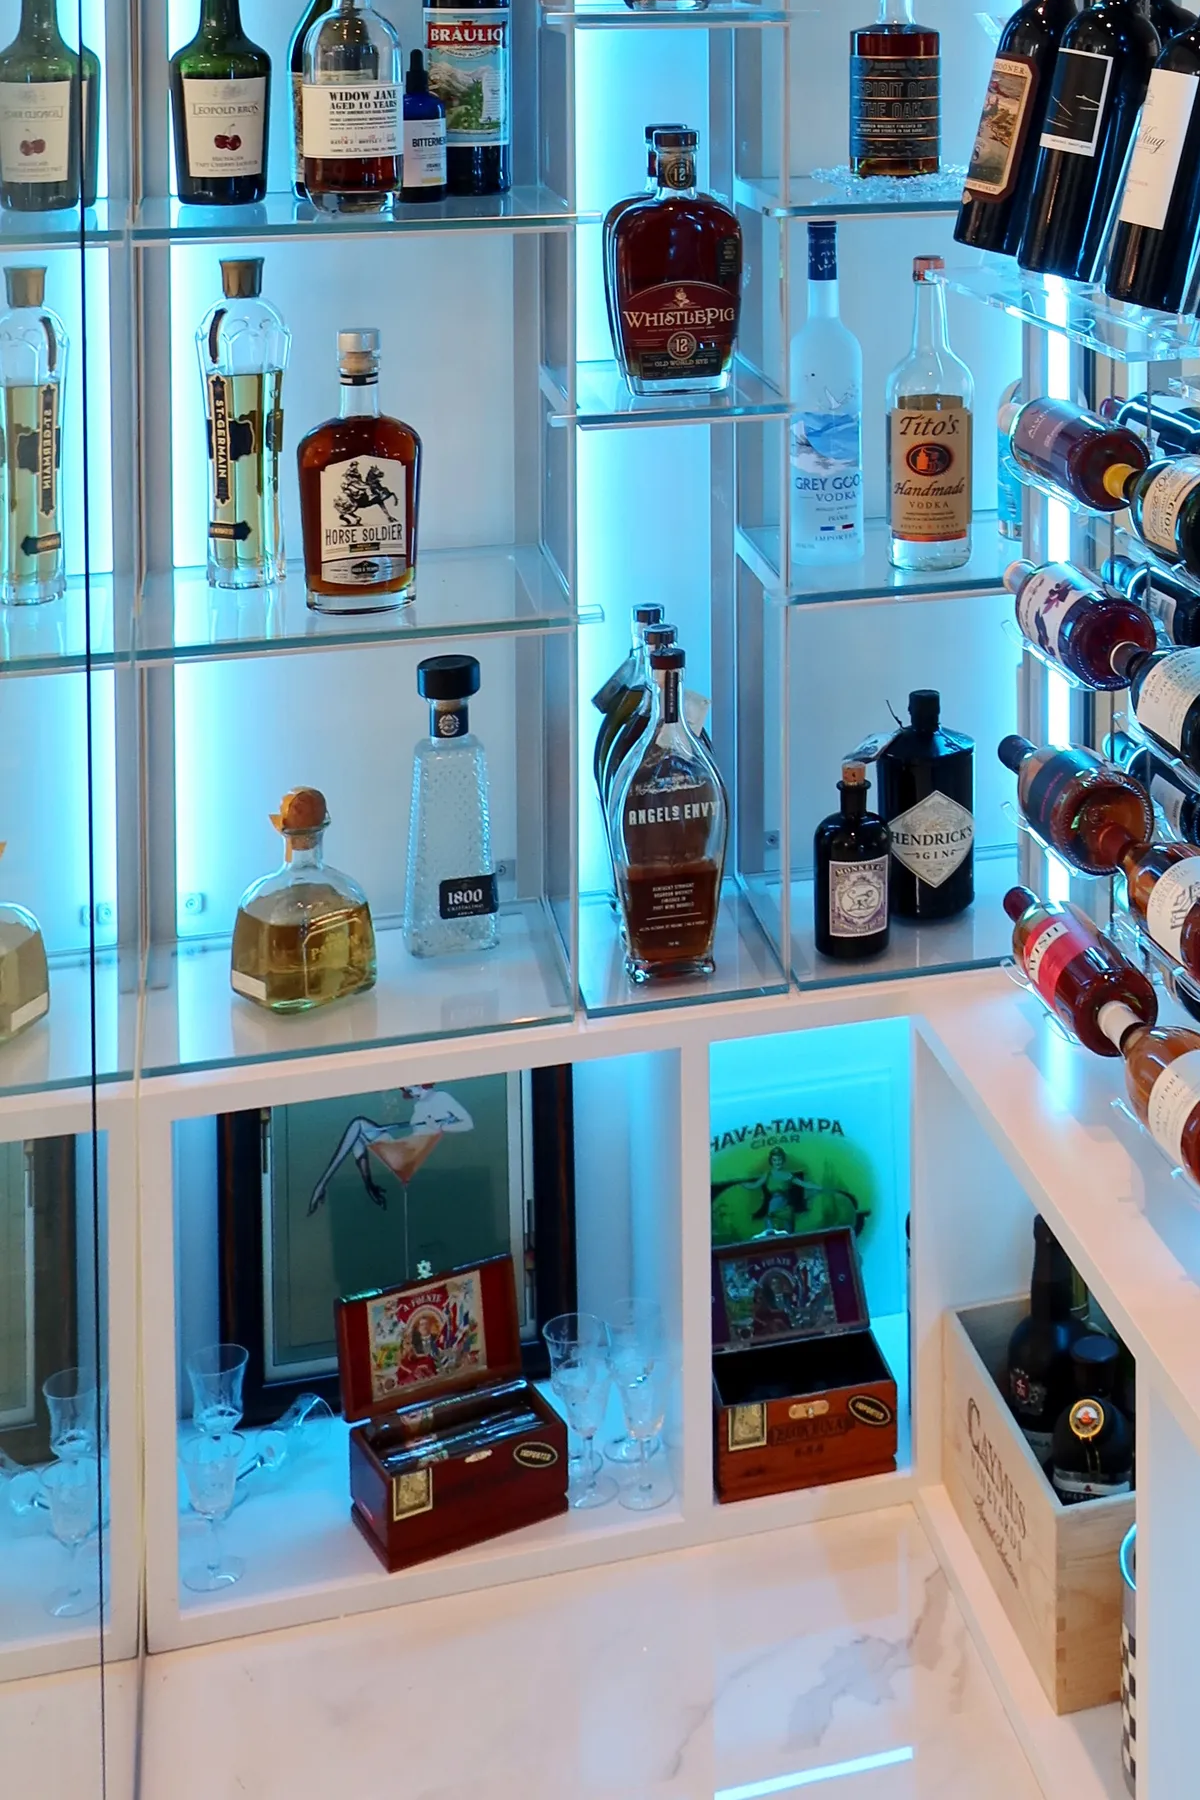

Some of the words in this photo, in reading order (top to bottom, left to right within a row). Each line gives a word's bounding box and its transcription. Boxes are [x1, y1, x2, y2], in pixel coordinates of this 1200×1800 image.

[329, 91, 371, 101] WIDOW
[374, 90, 396, 100] JANE
[193, 104, 236, 115] LEOPOLD
[330, 102, 355, 110] AGED
[373, 100, 397, 109] YEARS
[900, 414, 960, 437] Tito's
[215, 400, 227, 479] ST-GERMAIN
[796, 477, 829, 491] GREY
[832, 474, 861, 488] GOO
[893, 477, 966, 497] Handmade
[815, 491, 858, 502] VODKA
[910, 501, 950, 510] VODKA
[325, 529, 357, 546] HORSE
[362, 524, 403, 542] SOLDIER
[628, 805, 681, 827] ANGELS
[684, 801, 717, 819] ENVY
[892, 824, 973, 846] HENDRICK'S
[922, 851, 949, 860] GIN
[447, 889, 484, 906] 1800
[967, 1396, 1028, 1540] CAYMUS
